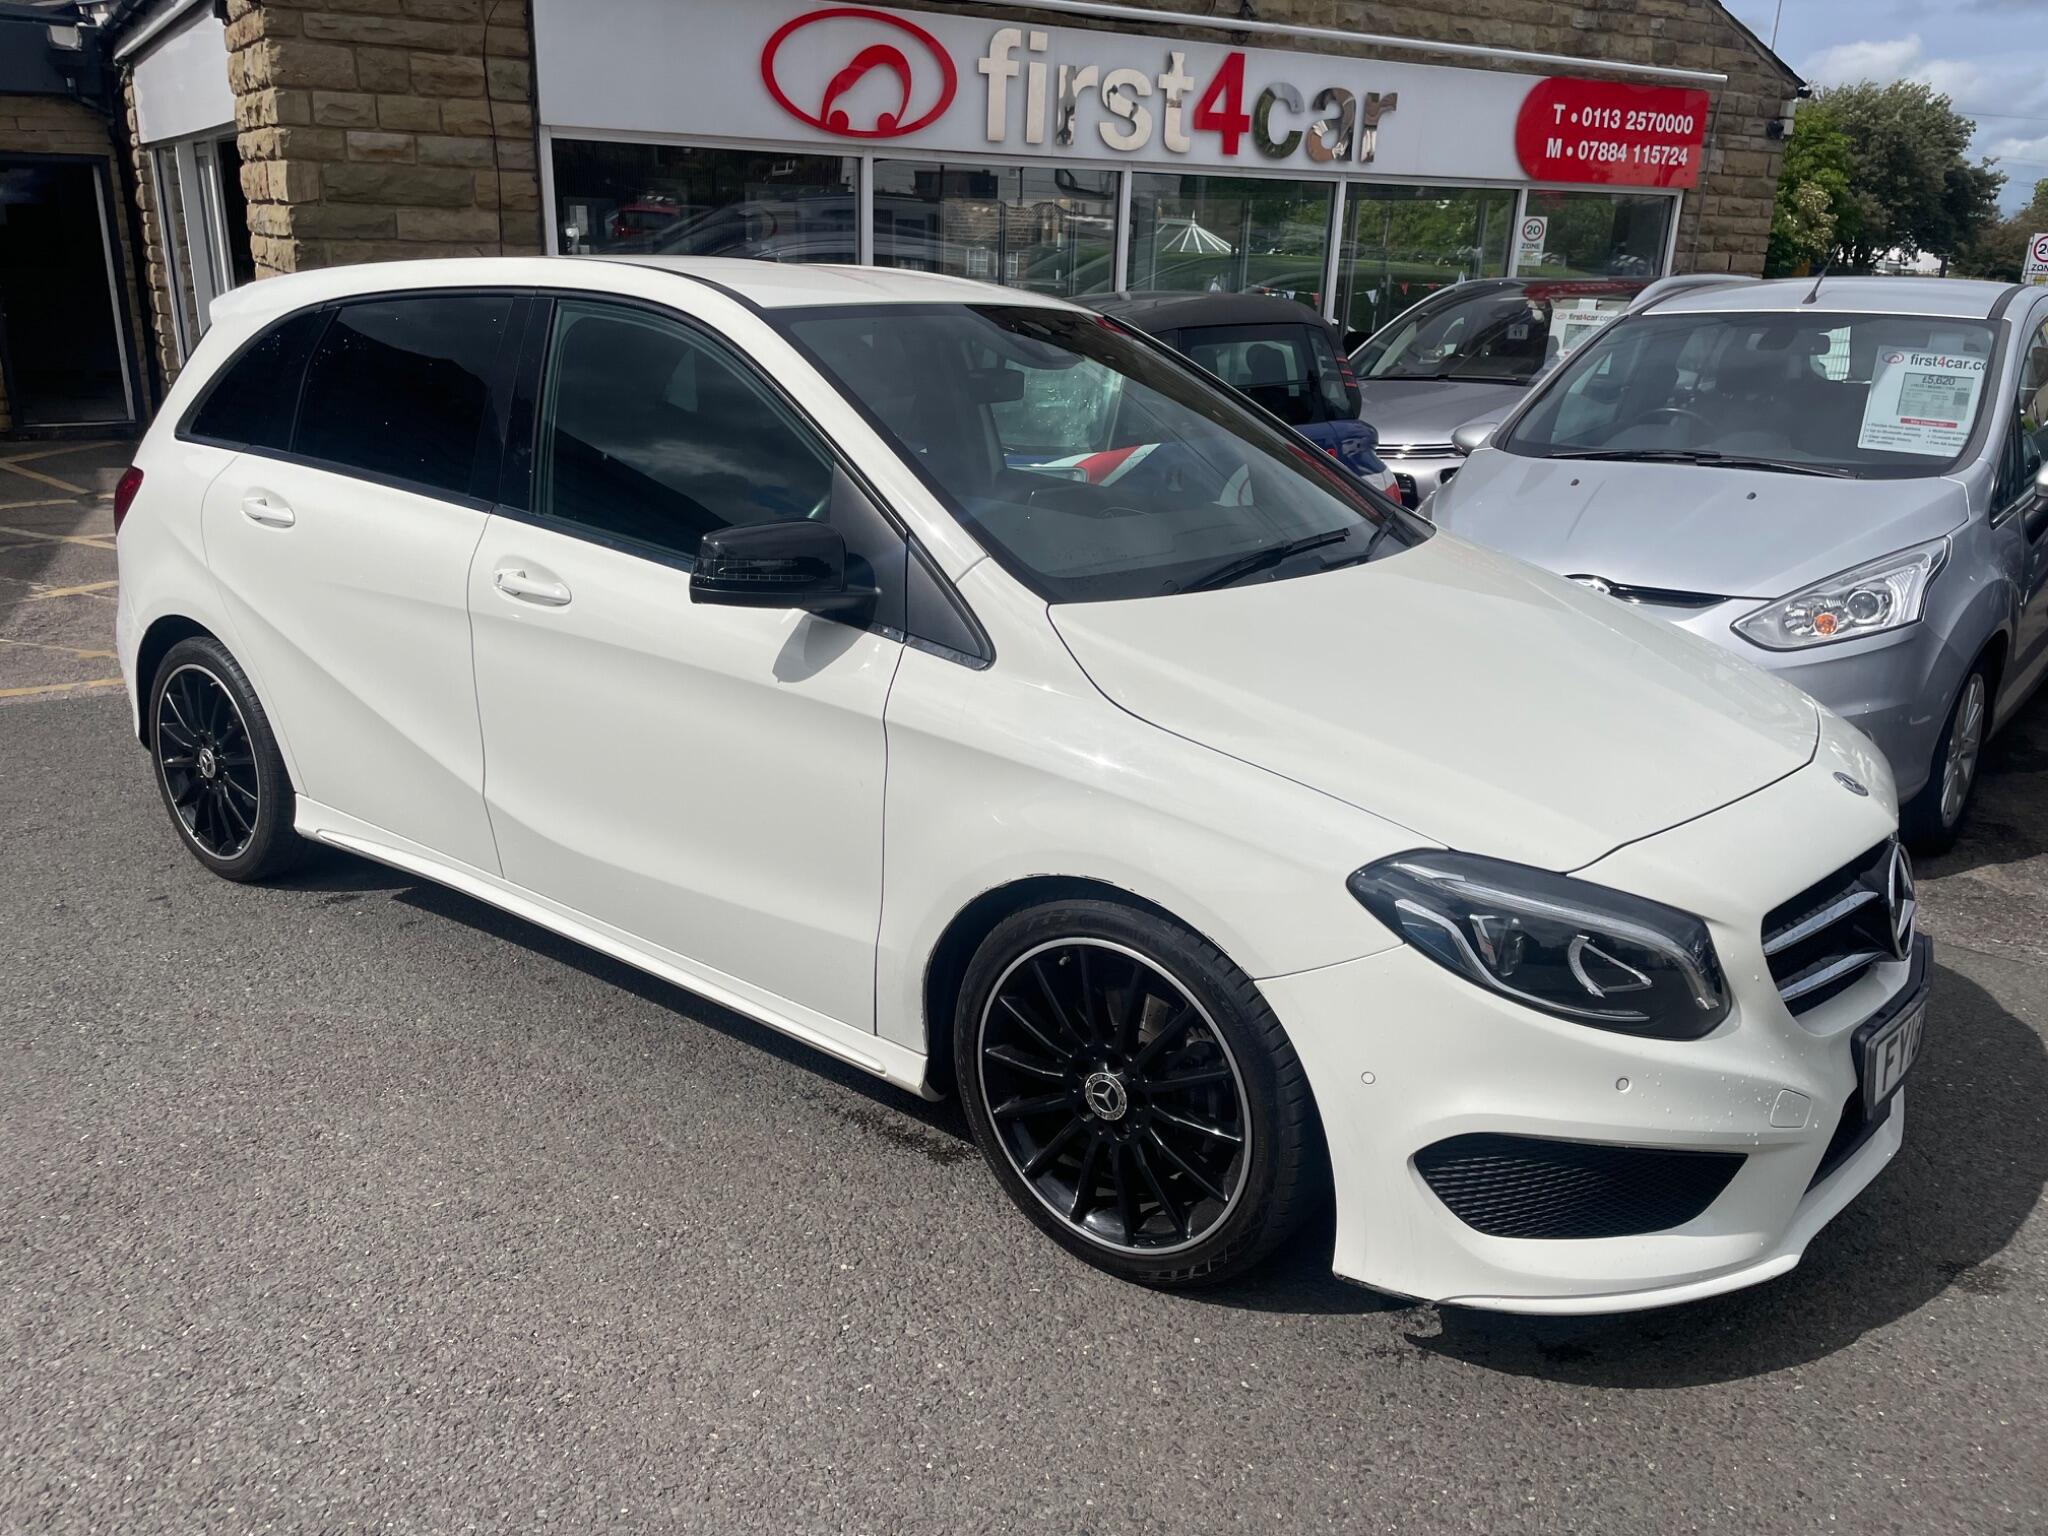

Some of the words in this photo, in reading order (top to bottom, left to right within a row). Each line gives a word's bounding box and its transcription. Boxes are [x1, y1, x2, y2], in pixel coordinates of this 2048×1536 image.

[978, 28, 1397, 164] first4car
[1553, 103, 1566, 125] T
[1581, 106, 1621, 129] 0113
[1625, 110, 1694, 135] 2570000
[1546, 137, 1562, 159] M
[1577, 140, 1627, 163] 07884
[1633, 146, 1688, 166] 115724
[1526, 224, 1541, 235] 20
[2038, 243, 2048, 255] 2
